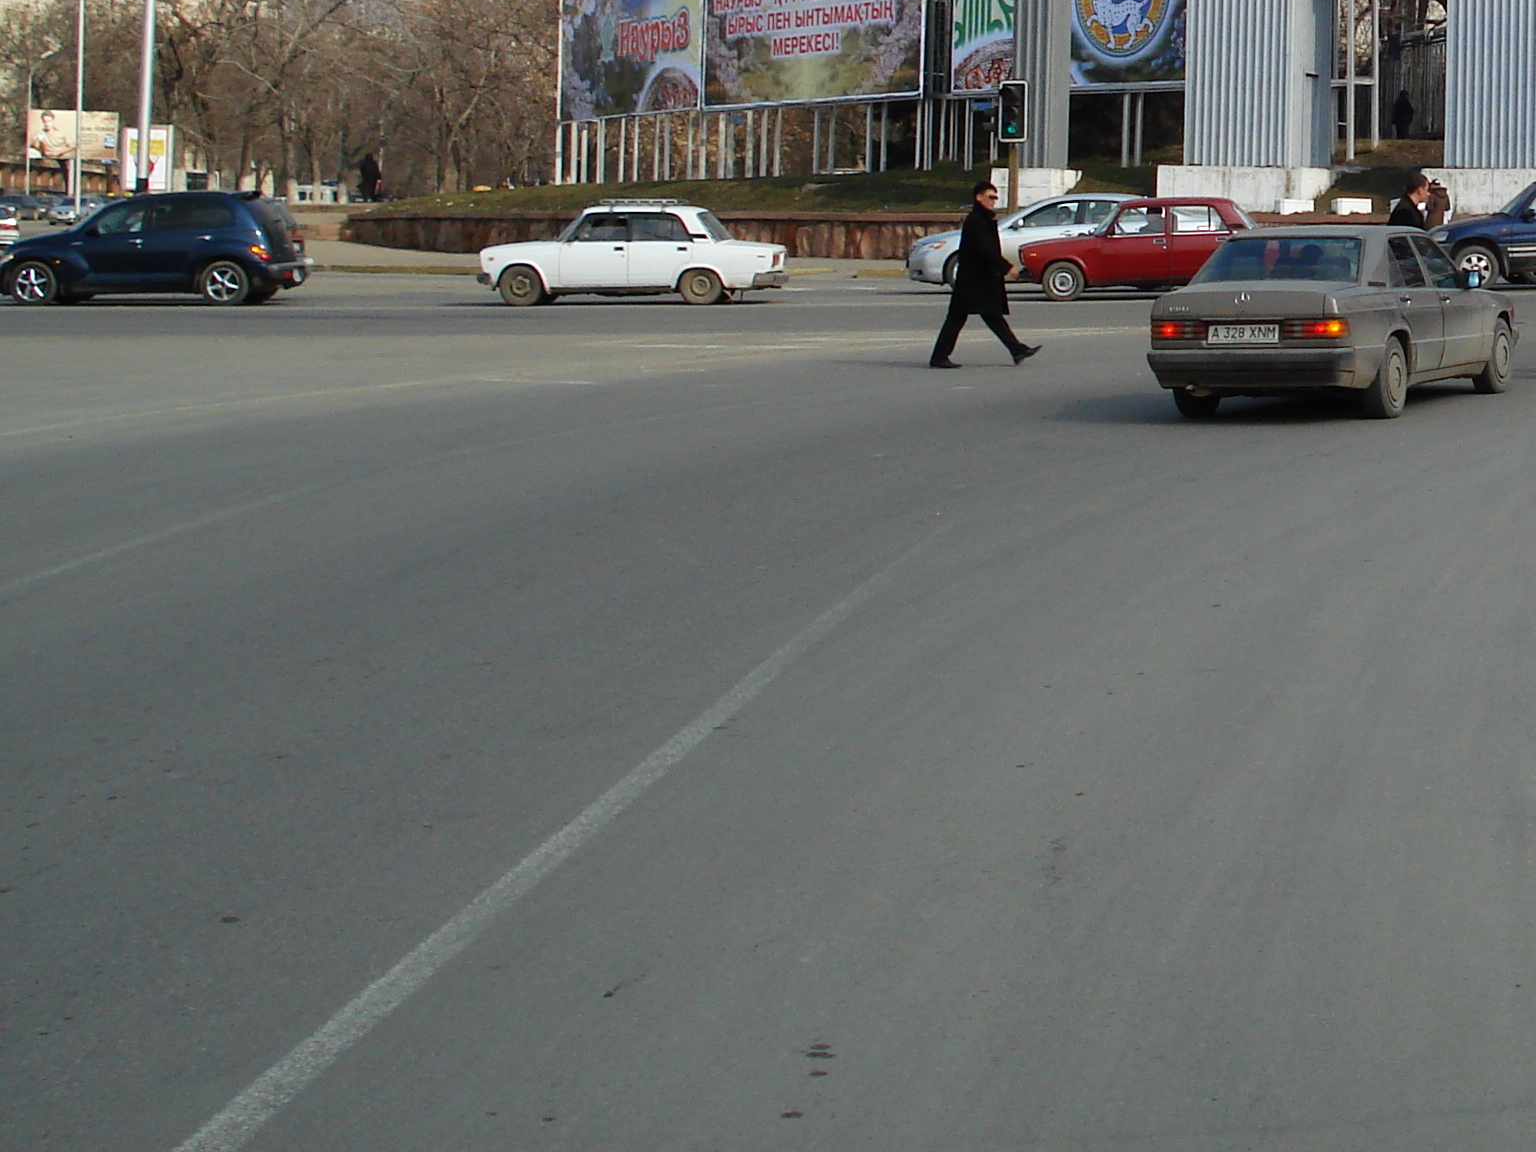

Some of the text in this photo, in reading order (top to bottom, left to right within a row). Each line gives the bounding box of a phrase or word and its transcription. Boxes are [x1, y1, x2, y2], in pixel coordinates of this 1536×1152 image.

[727, 14, 763, 35] ЫРЫС
[767, 11, 791, 32] ПЕН
[772, 32, 840, 56] МЕРЕКЕСІ!
[1211, 327, 1220, 339] A
[1223, 327, 1245, 339] 328
